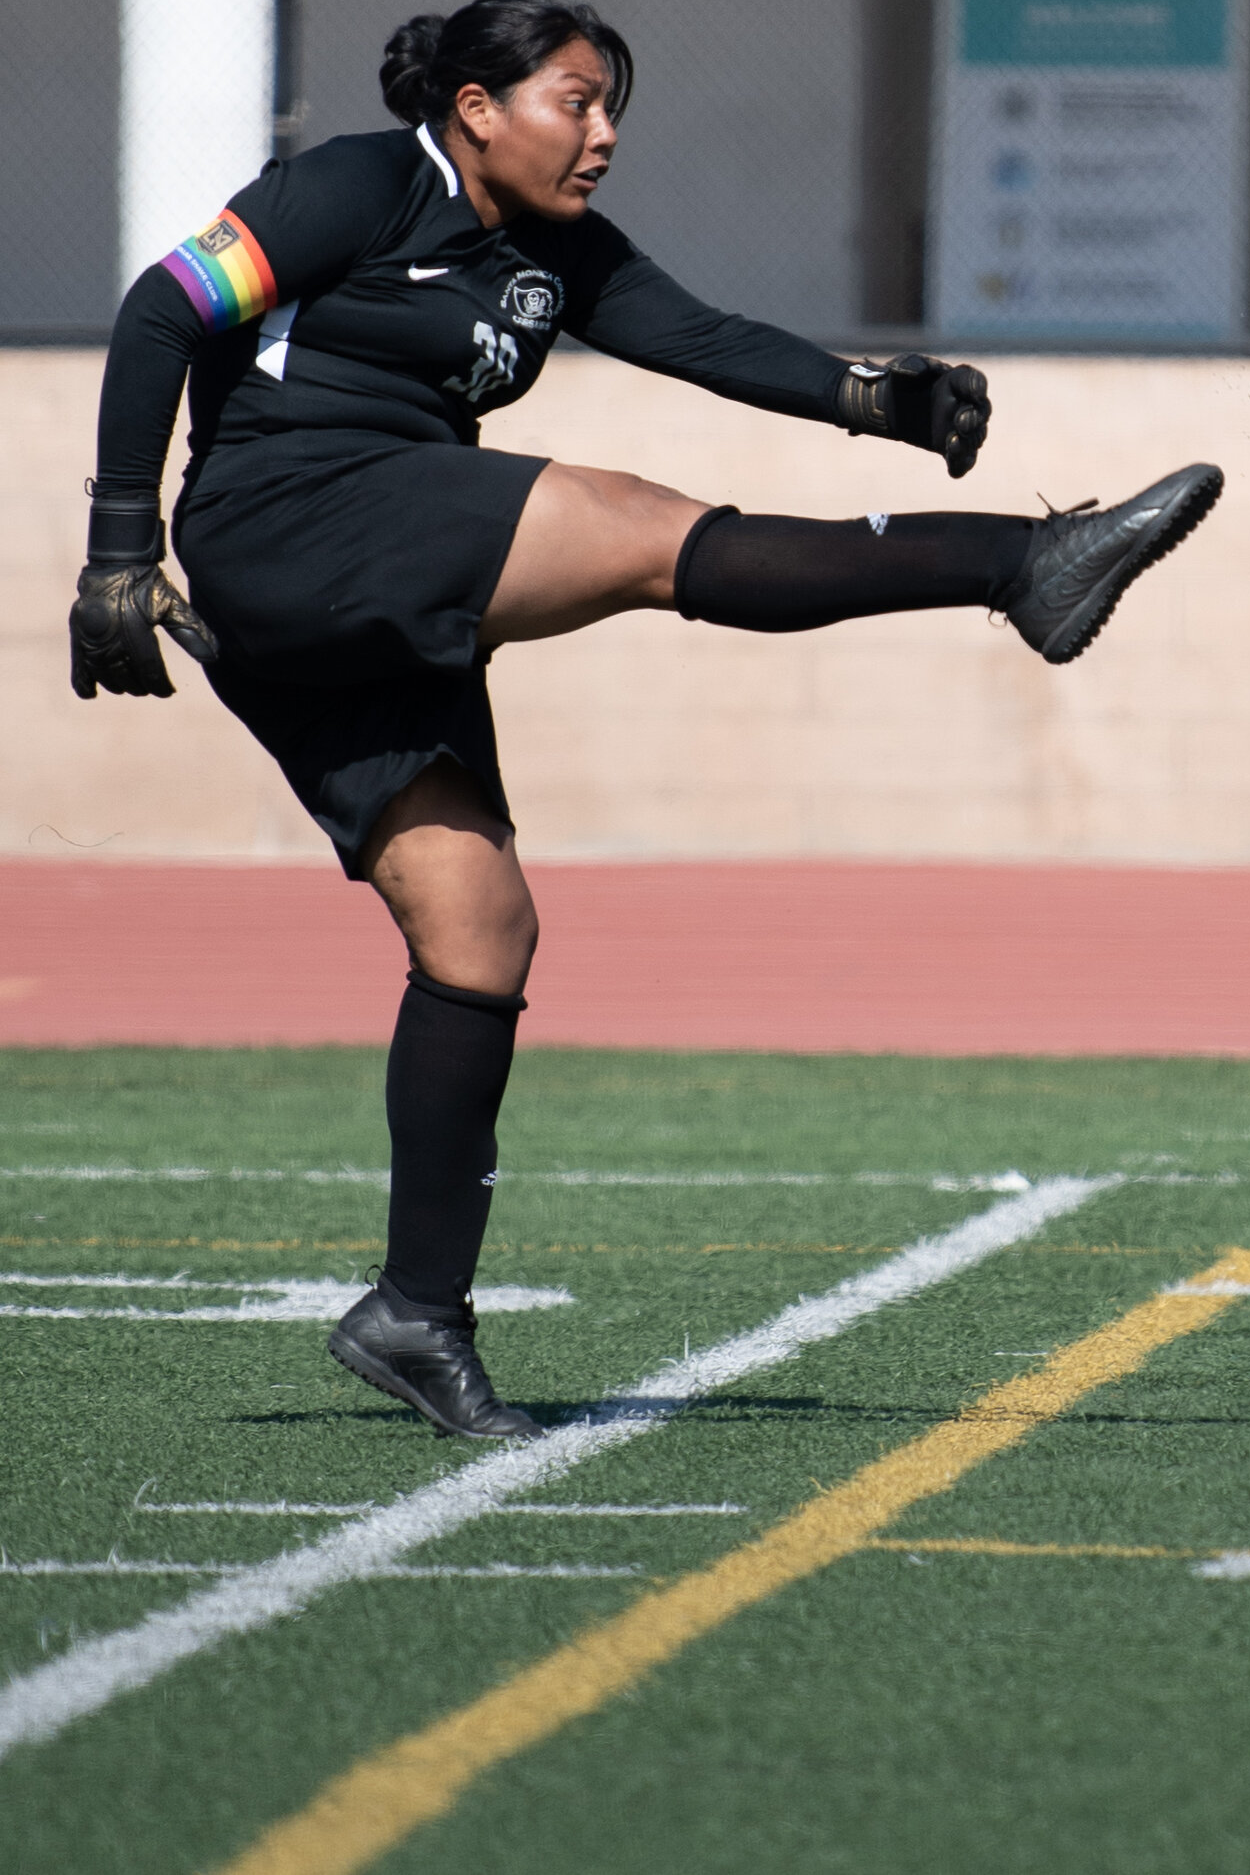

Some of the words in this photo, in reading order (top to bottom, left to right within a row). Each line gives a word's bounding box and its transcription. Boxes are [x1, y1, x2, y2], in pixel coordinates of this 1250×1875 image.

[191, 258, 208, 281] SHAVE
[500, 277, 518, 309] SANTA
[515, 269, 553, 282] MONICA
